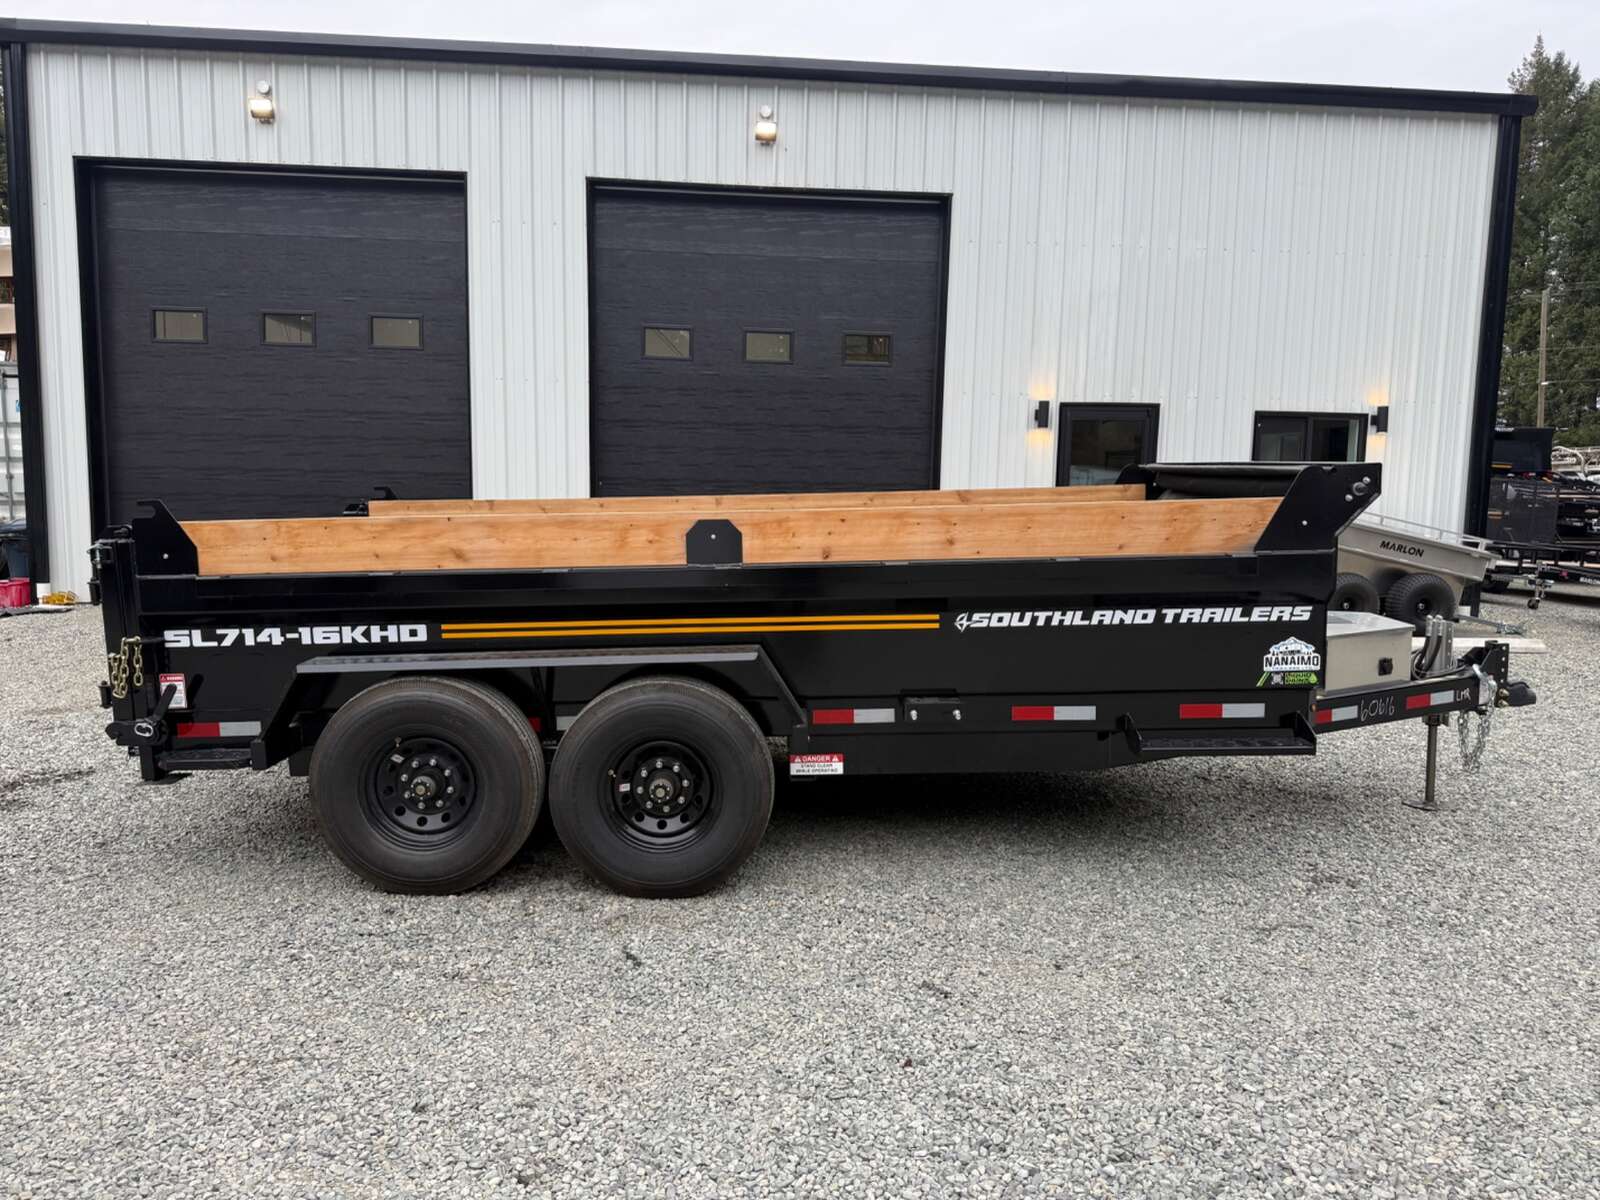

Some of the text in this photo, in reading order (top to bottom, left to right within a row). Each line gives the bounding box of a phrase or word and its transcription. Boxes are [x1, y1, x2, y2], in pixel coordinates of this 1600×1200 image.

[1379, 540, 1424, 557] MARLON
[969, 606, 1313, 628] SOUTHLAND TRAILERS
[163, 624, 428, 648] SL714-16KHD
[1264, 655, 1320, 668] NANAIMO
